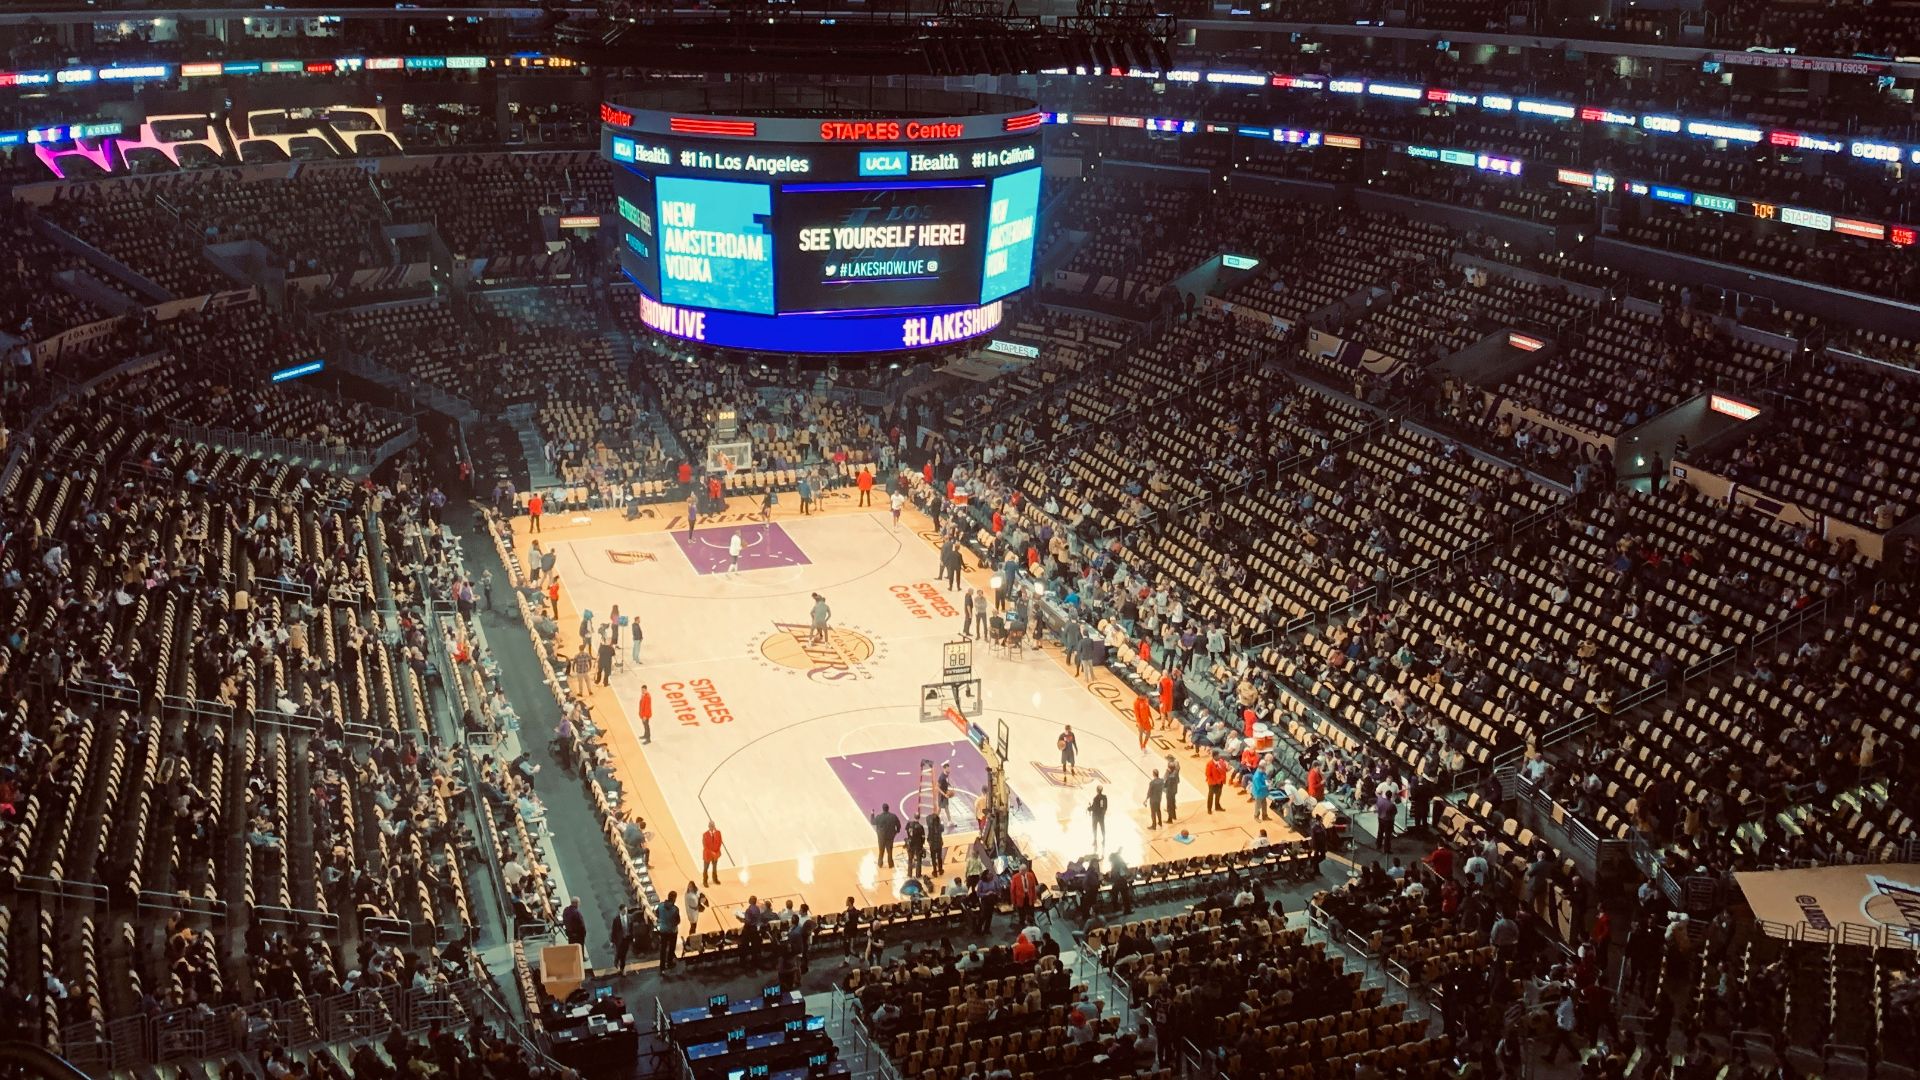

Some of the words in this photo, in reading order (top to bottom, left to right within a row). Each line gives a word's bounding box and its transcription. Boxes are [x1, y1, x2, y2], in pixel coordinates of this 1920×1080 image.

[415, 59, 444, 67] DELTA
[95, 124, 120, 134] DELTA
[820, 121, 900, 140] STAPLES
[906, 121, 964, 140] Center
[635, 145, 670, 165] Health
[972, 153, 986, 168] #1
[987, 151, 998, 167] in
[1407, 145, 1437, 159] Spectrum
[680, 151, 698, 167] #1
[699, 152, 711, 168] in
[715, 153, 742, 170] Los
[745, 155, 810, 175] Angeles
[866, 157, 902, 170] UCLA
[910, 154, 959, 171] Health
[661, 200, 697, 228] NEW
[1703, 198, 1734, 210] DELTA
[1783, 209, 1830, 229] STAPLES
[799, 228, 831, 251] SEE
[832, 225, 916, 250] YOURSELF
[918, 224, 965, 247] HERE!
[665, 254, 713, 283] VODKA
[839, 260, 925, 277] #LAKESHOWLIVE
[994, 342, 1029, 356] STAPLES
[888, 585, 933, 620] Center
[912, 583, 960, 618] STAPLES
[661, 681, 701, 727] Center
[689, 678, 735, 725] STAPLES
